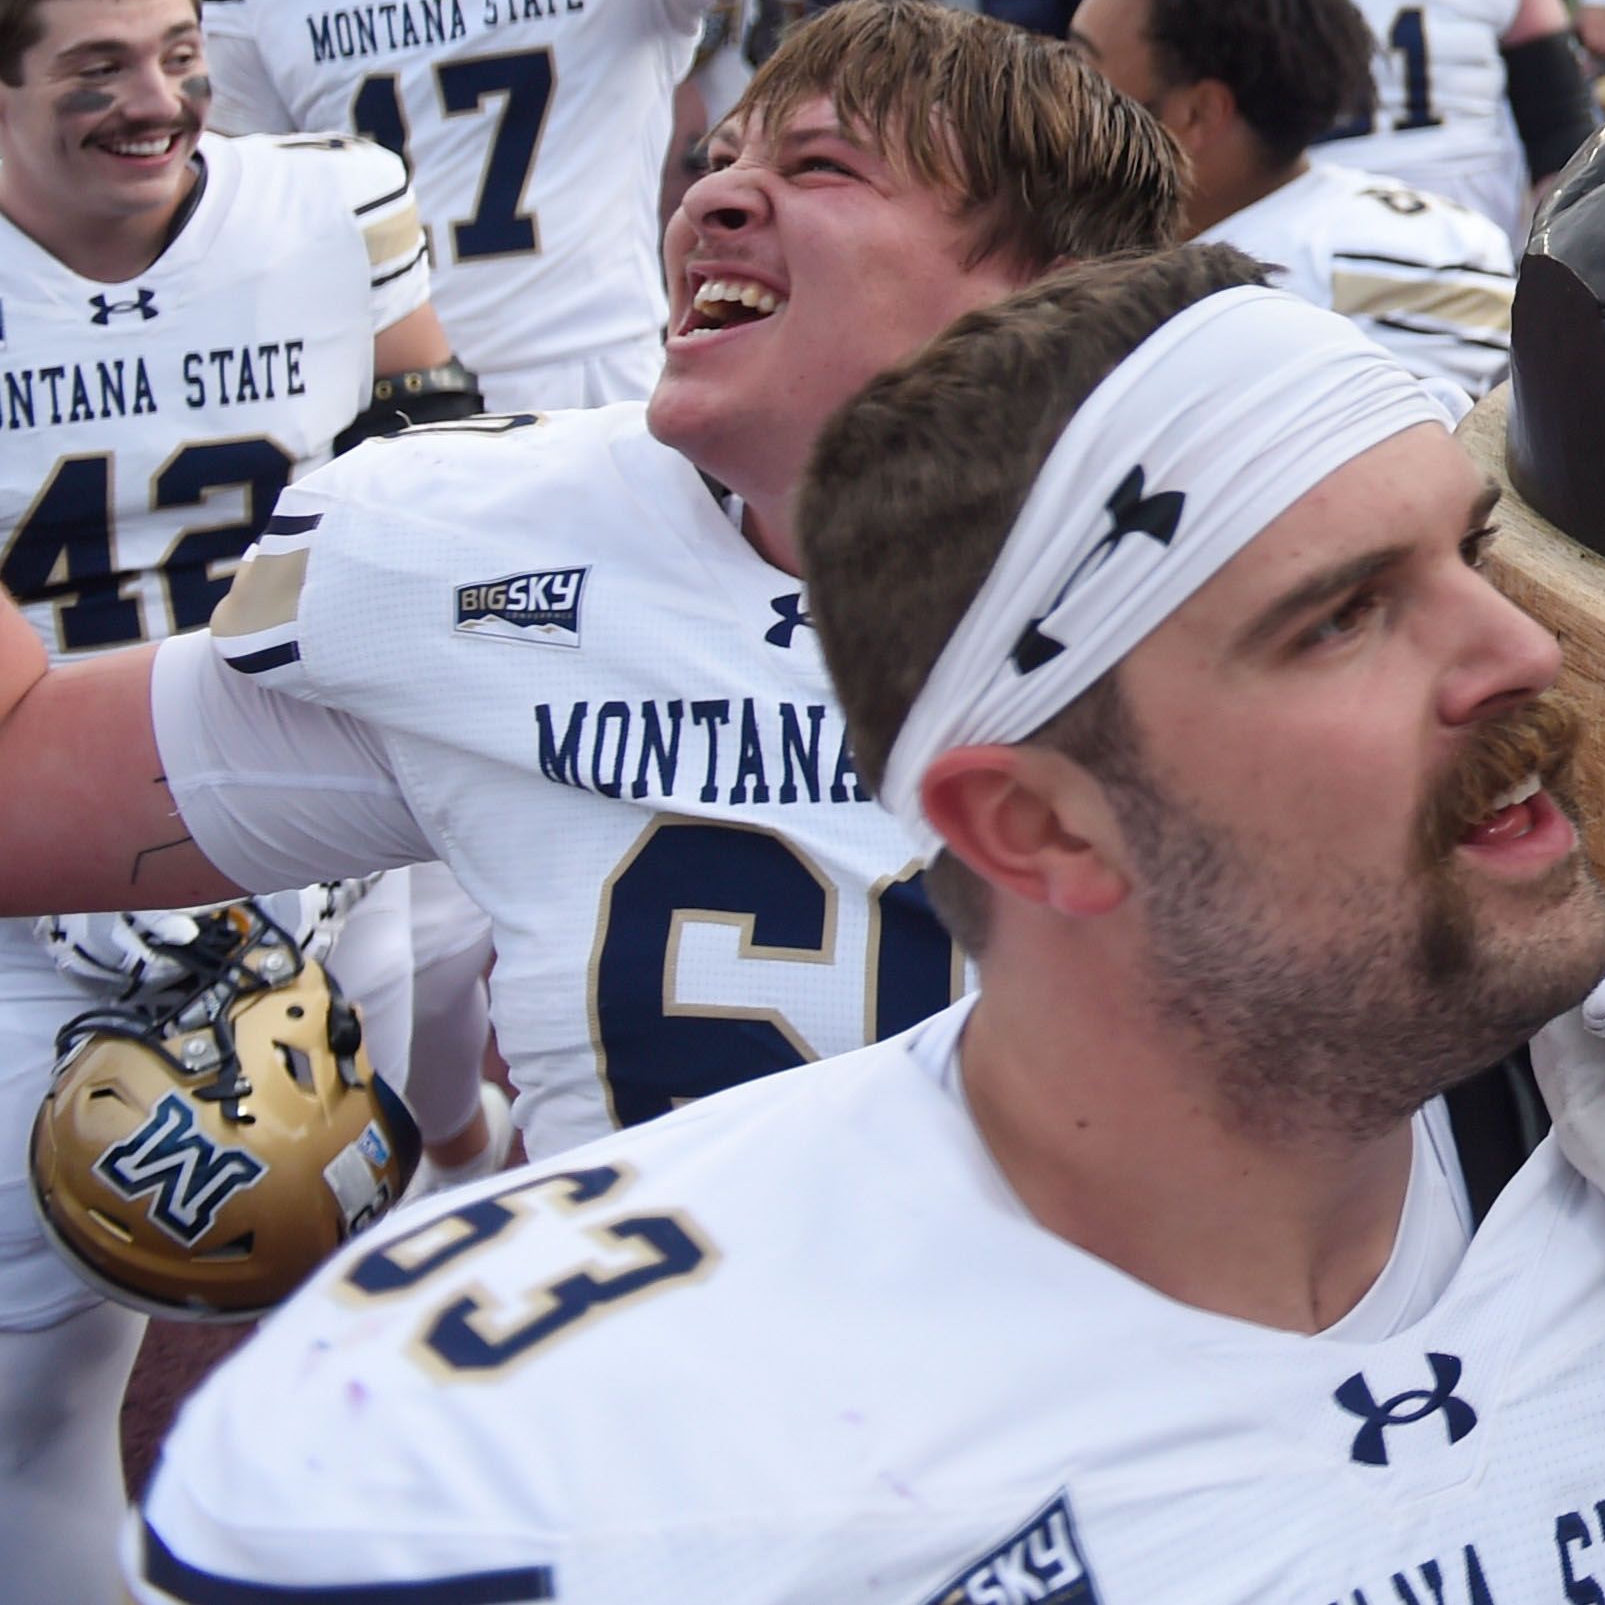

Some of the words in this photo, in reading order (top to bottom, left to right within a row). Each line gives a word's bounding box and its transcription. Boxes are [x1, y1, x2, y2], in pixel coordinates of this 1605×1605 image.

[350, 46, 560, 269] 17
[0, 357, 157, 430] NTANA
[183, 339, 306, 409] STATE
[0, 431, 298, 653] 42
[461, 572, 581, 612] BIGSKY
[535, 697, 874, 805] MONTANA
[335, 1160, 722, 1380] 63
